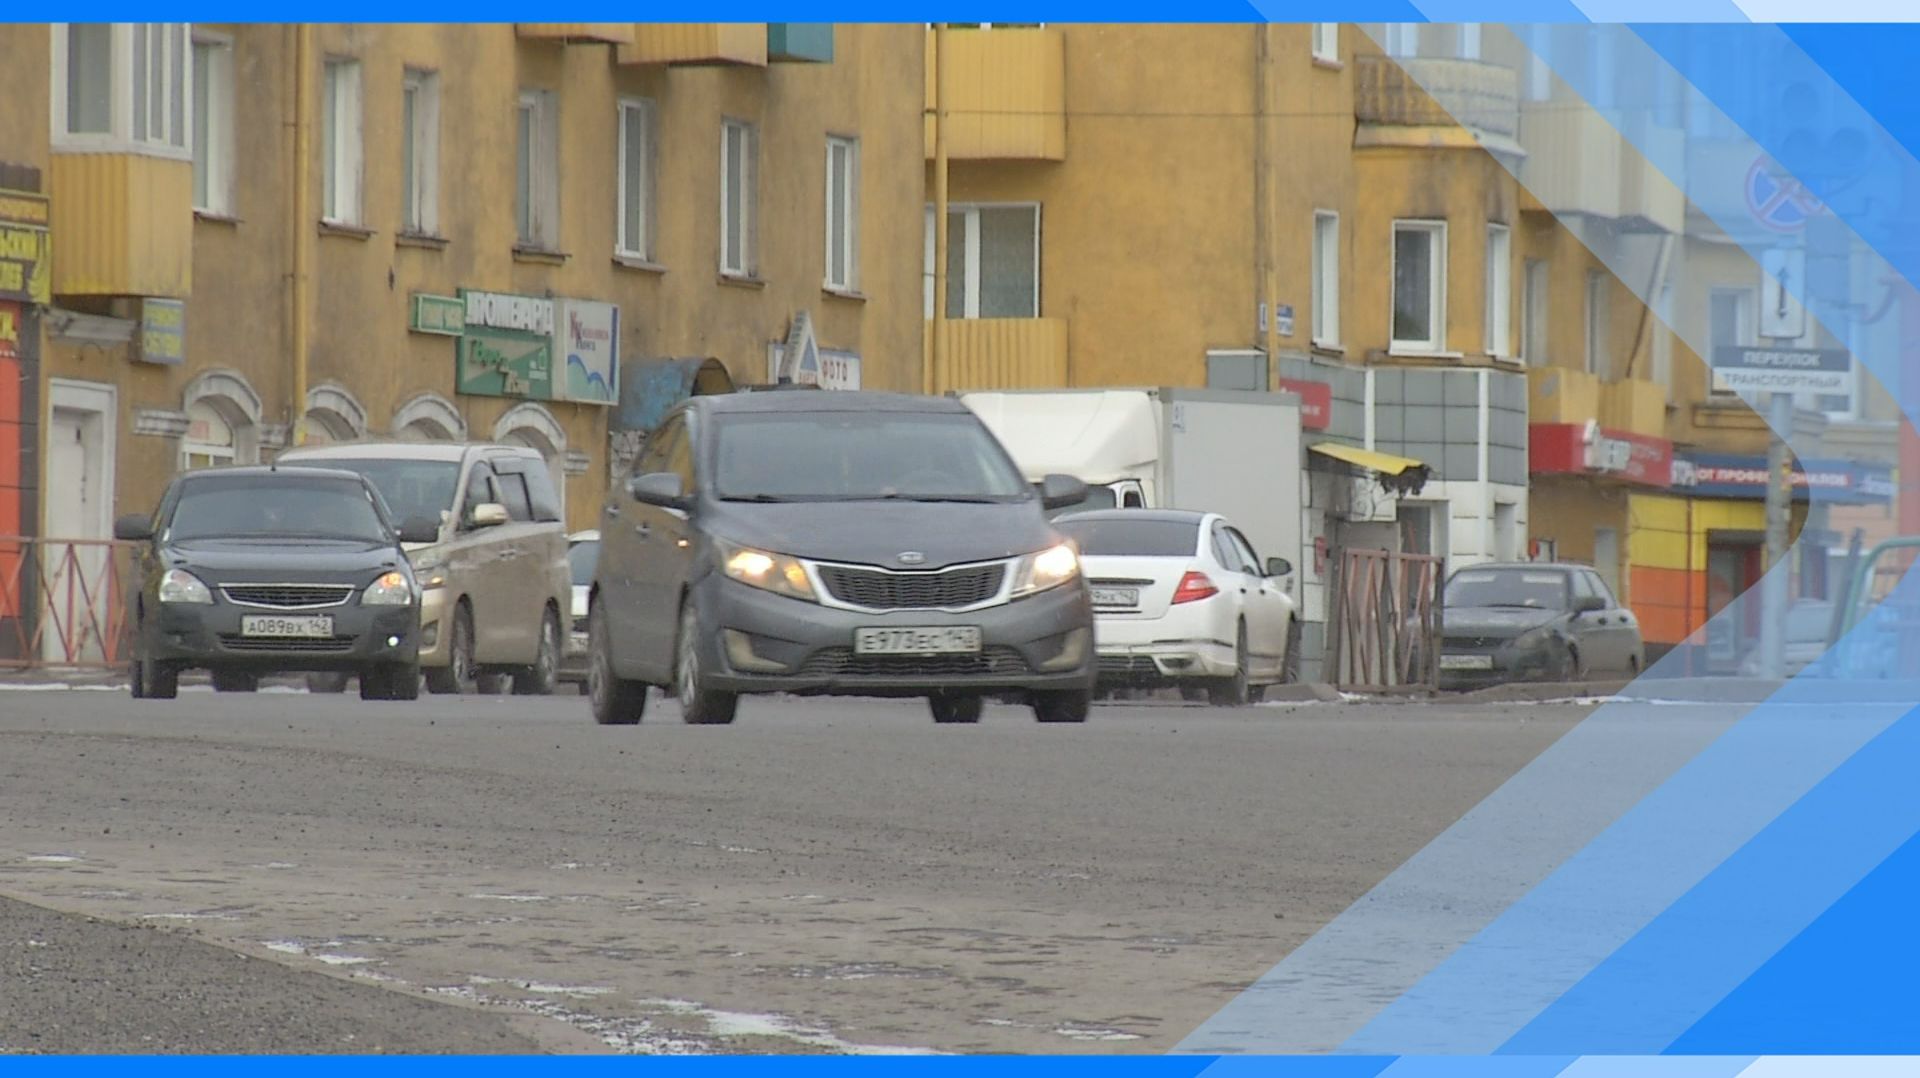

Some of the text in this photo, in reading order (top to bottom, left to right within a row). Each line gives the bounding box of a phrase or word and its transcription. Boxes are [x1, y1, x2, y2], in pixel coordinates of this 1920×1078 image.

[465, 291, 554, 336] ЛОМБАРД
[1742, 351, 1822, 368] ПЕРЕУЛОК
[821, 359, 849, 382] ФОТО
[1724, 372, 1843, 388] ТРАНСПОРТНЫЙ
[249, 618, 303, 635] А089ВХ
[863, 629, 943, 651] Е973ЕС
